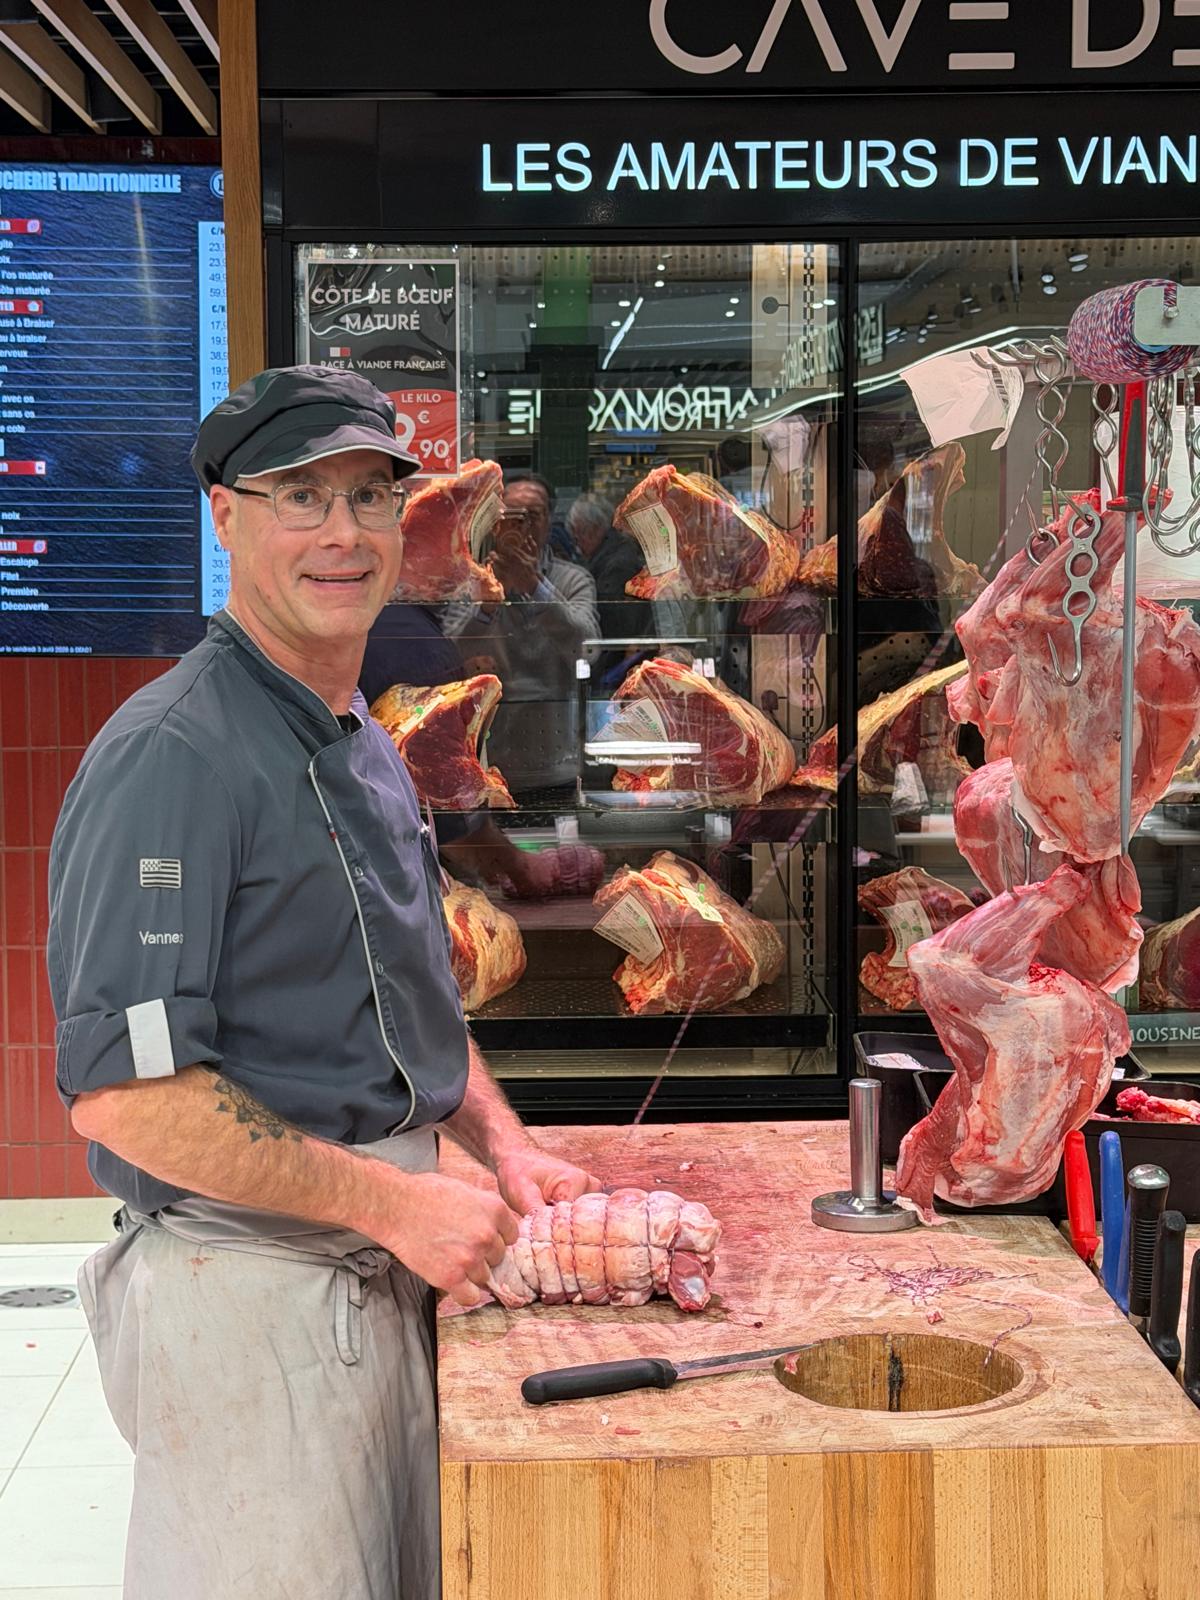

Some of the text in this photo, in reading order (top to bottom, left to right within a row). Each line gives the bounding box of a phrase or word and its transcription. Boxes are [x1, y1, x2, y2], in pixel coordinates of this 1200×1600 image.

[1071, 0, 1200, 69] D
[482, 134, 1197, 192] LES AMATEURS DE VIAN
[59, 172, 181, 193] TRADITIONNELLE
[311, 285, 454, 305] CÔTE DE BŒUF
[346, 310, 421, 331] MATURÉ
[320, 360, 345, 369] RACE
[356, 360, 393, 369] VIANDE
[393, 360, 446, 372] FRANÇAISE
[402, 394, 441, 403] LE KILO
[139, 930, 184, 945] Vannes
[1130, 1027, 1200, 1042] OUSINE
